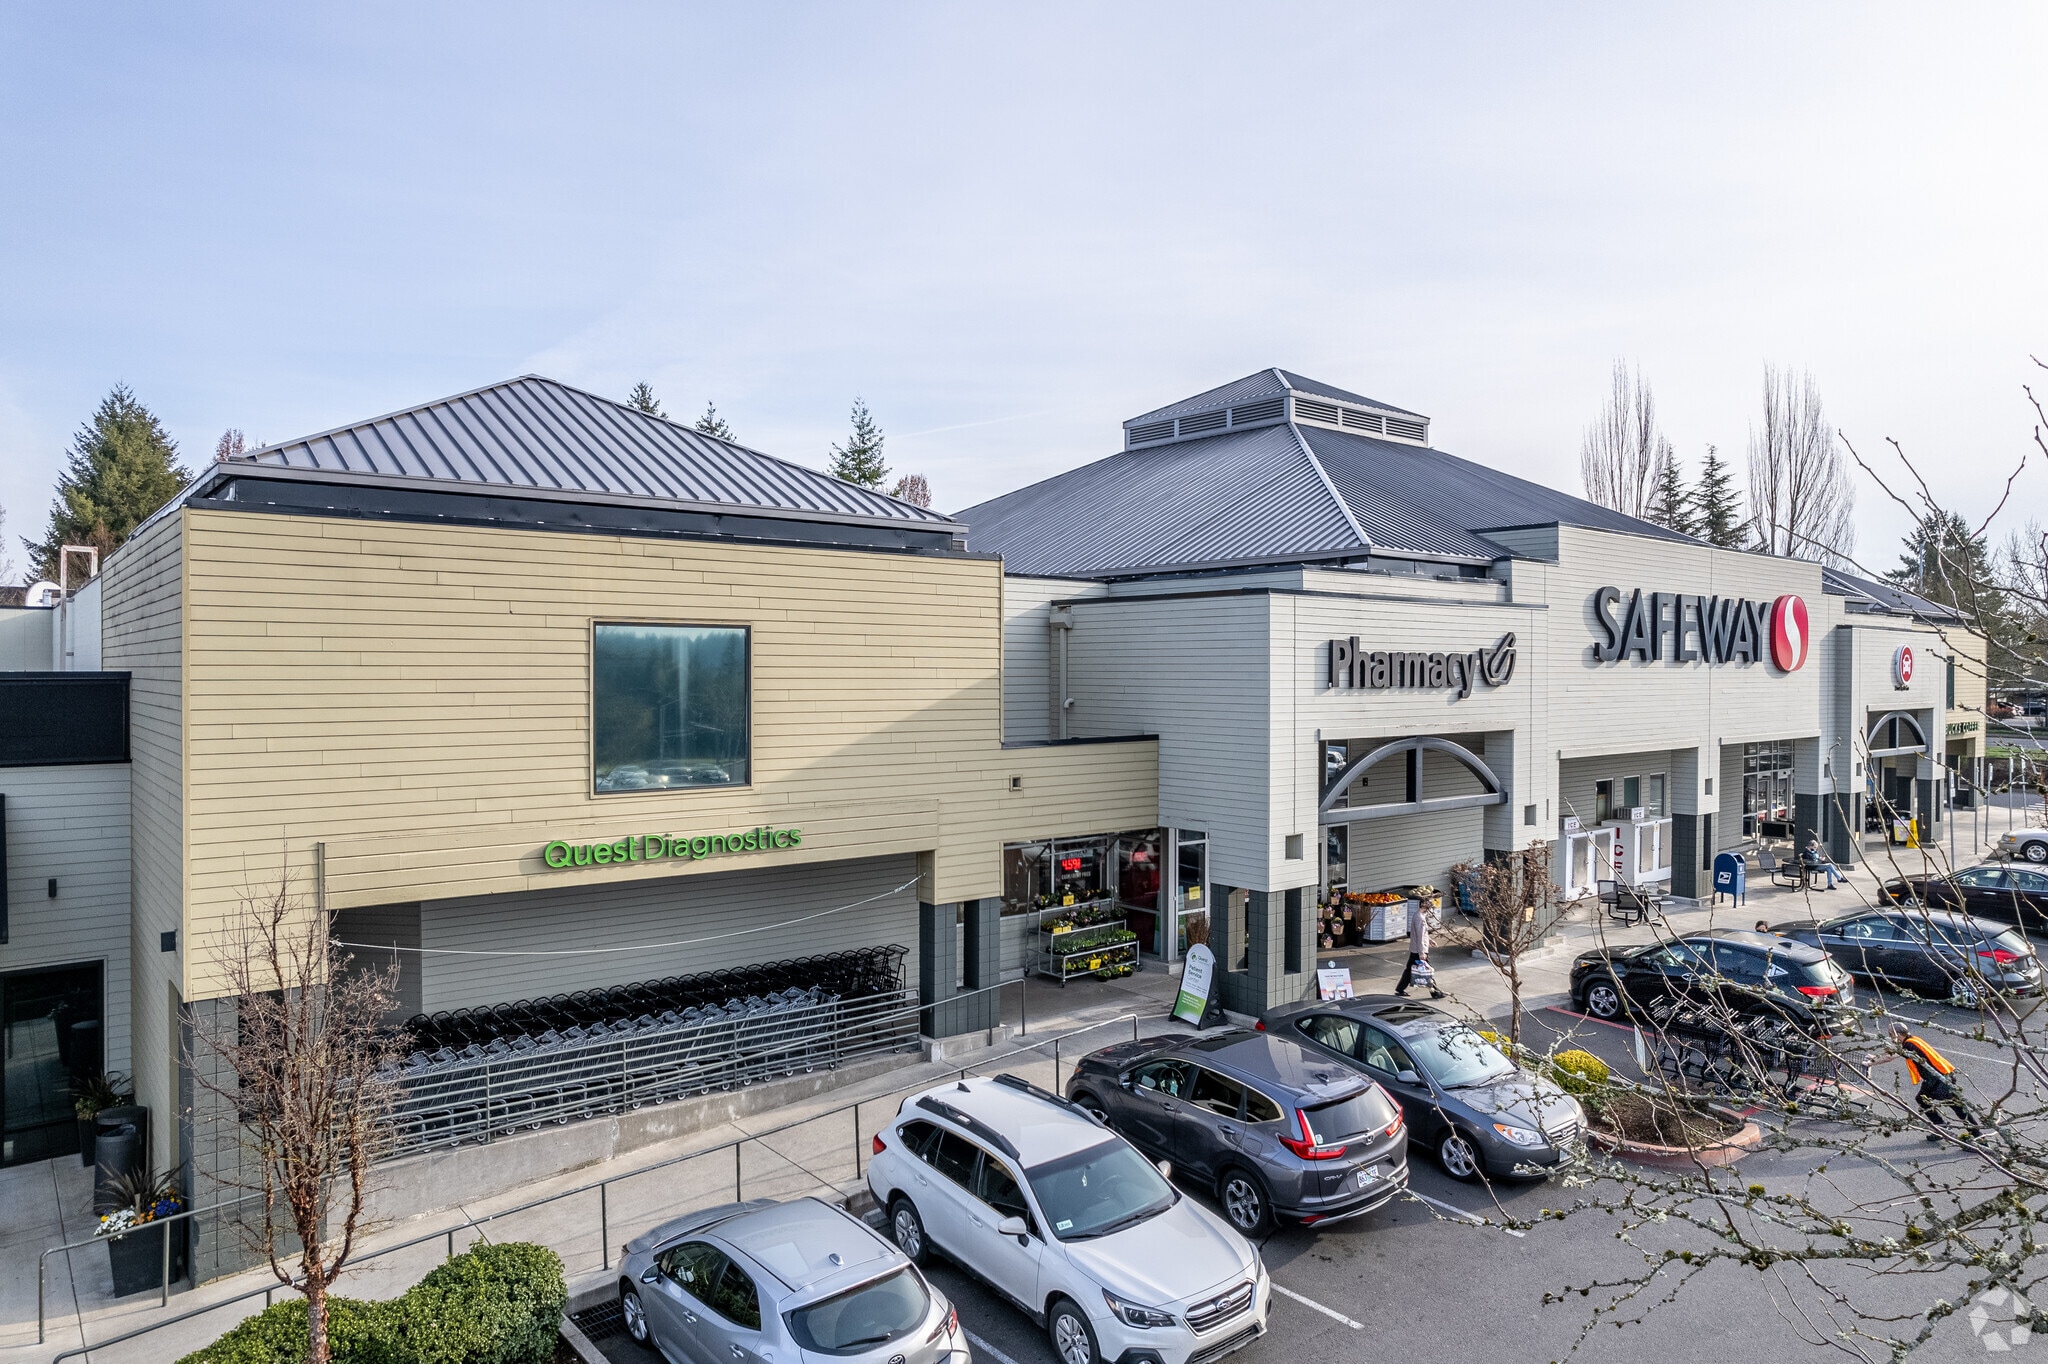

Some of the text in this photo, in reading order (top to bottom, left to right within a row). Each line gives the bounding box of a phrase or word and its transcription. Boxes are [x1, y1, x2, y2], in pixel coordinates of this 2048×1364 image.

[1593, 585, 1772, 664] SAFEWAY
[1328, 635, 1477, 699] Pharmacy
[543, 825, 803, 869] Quest Diagnostics
